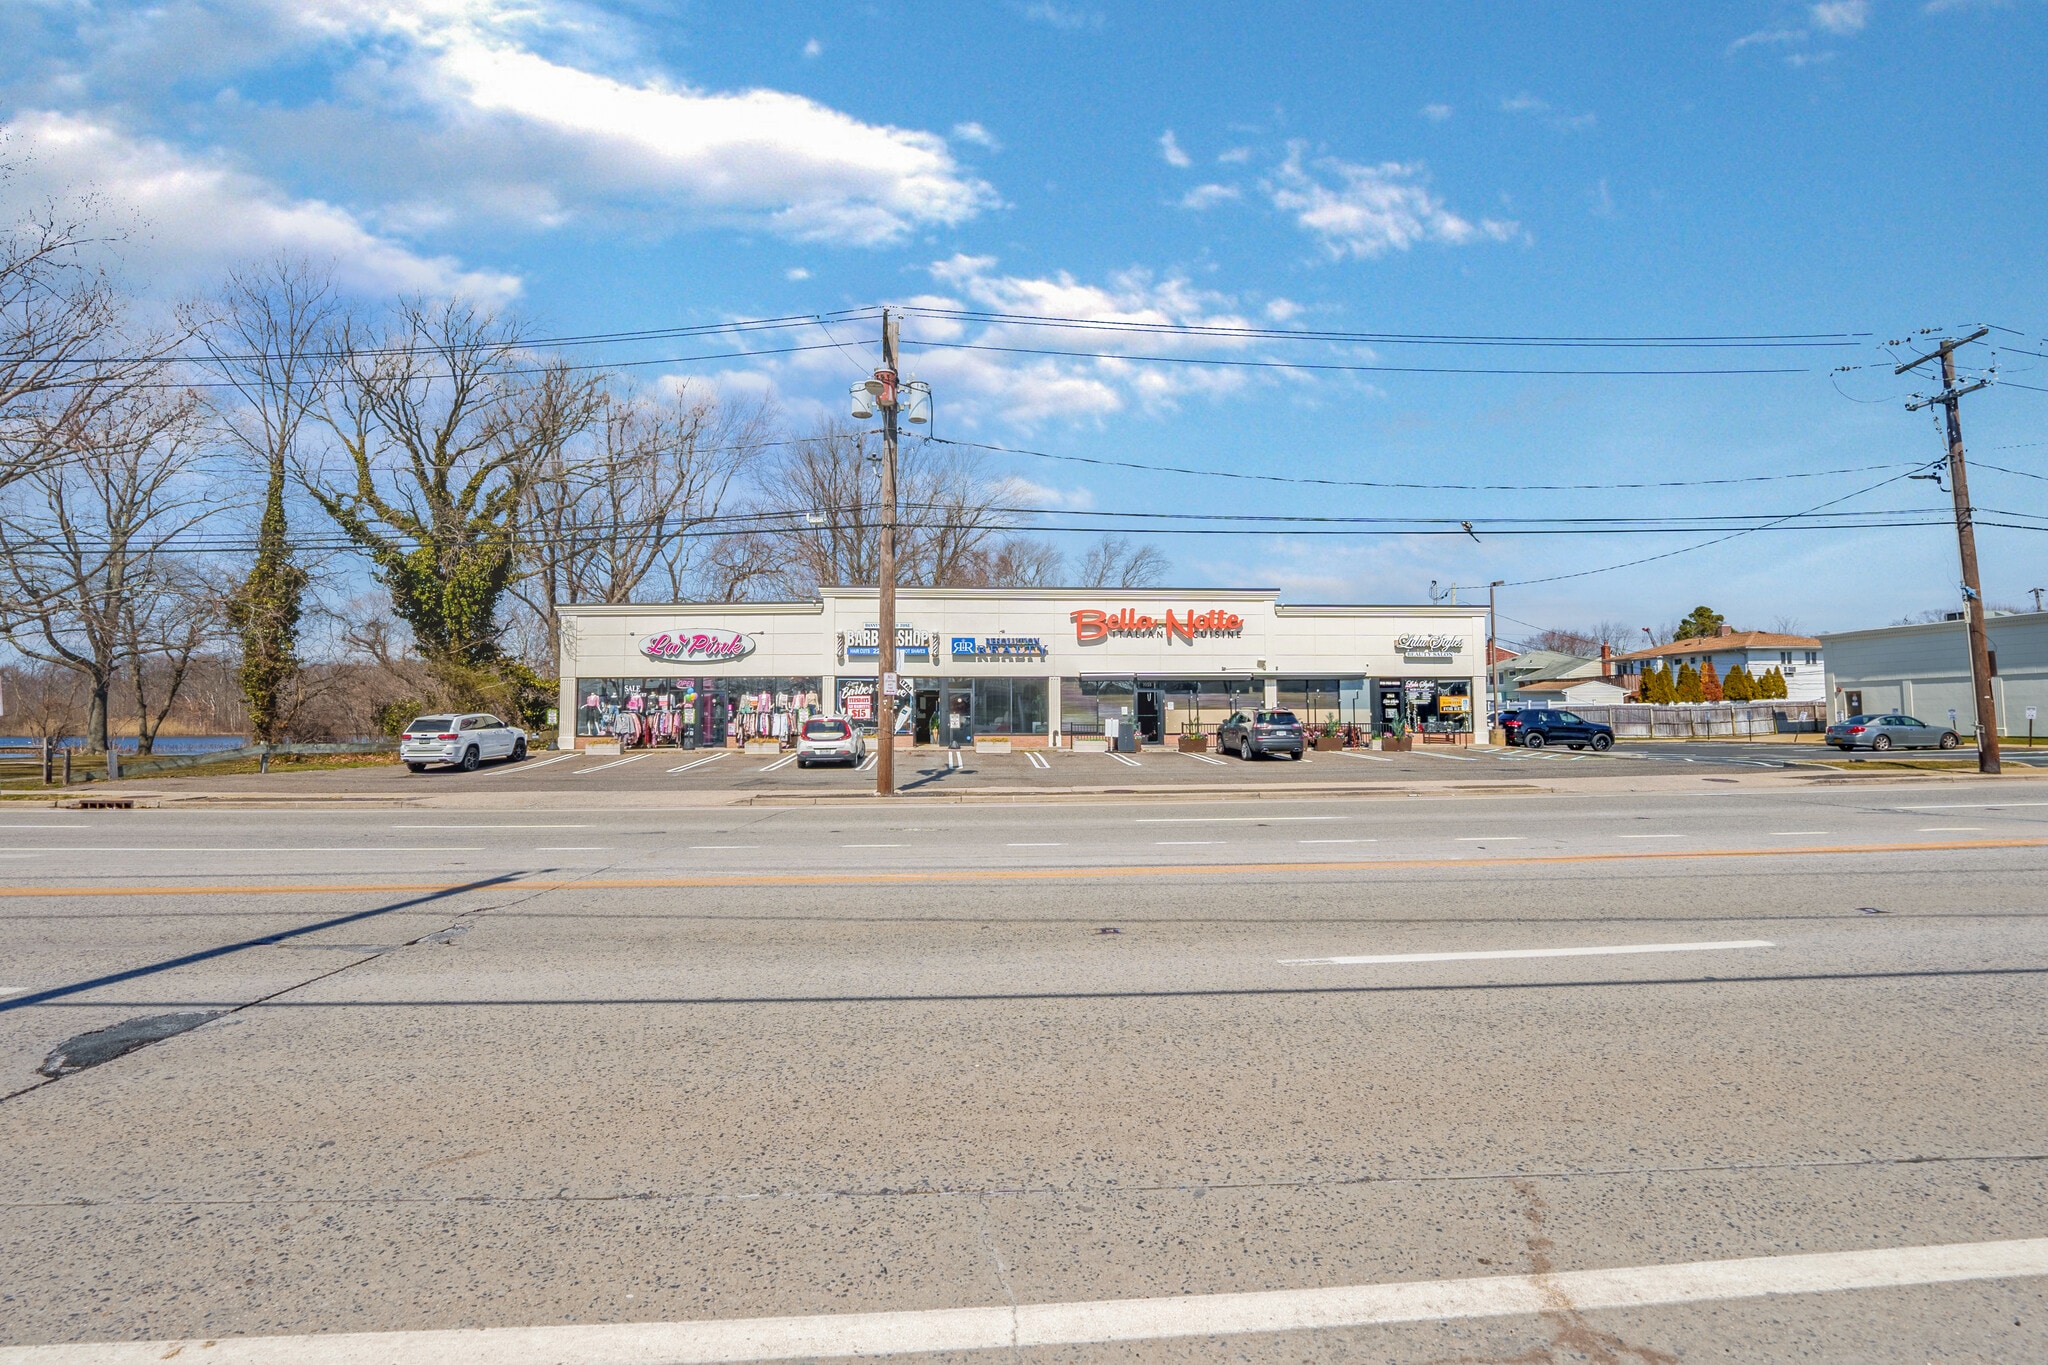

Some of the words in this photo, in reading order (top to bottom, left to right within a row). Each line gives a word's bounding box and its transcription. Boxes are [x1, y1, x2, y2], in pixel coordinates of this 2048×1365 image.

[1070, 608, 1157, 639] Bella
[1166, 609, 1244, 638] Notte
[687, 634, 743, 655] Pink
[898, 630, 929, 646] SHOP
[977, 644, 1048, 655] REALTY
[842, 683, 875, 699] Barber
[851, 709, 866, 717] $15
